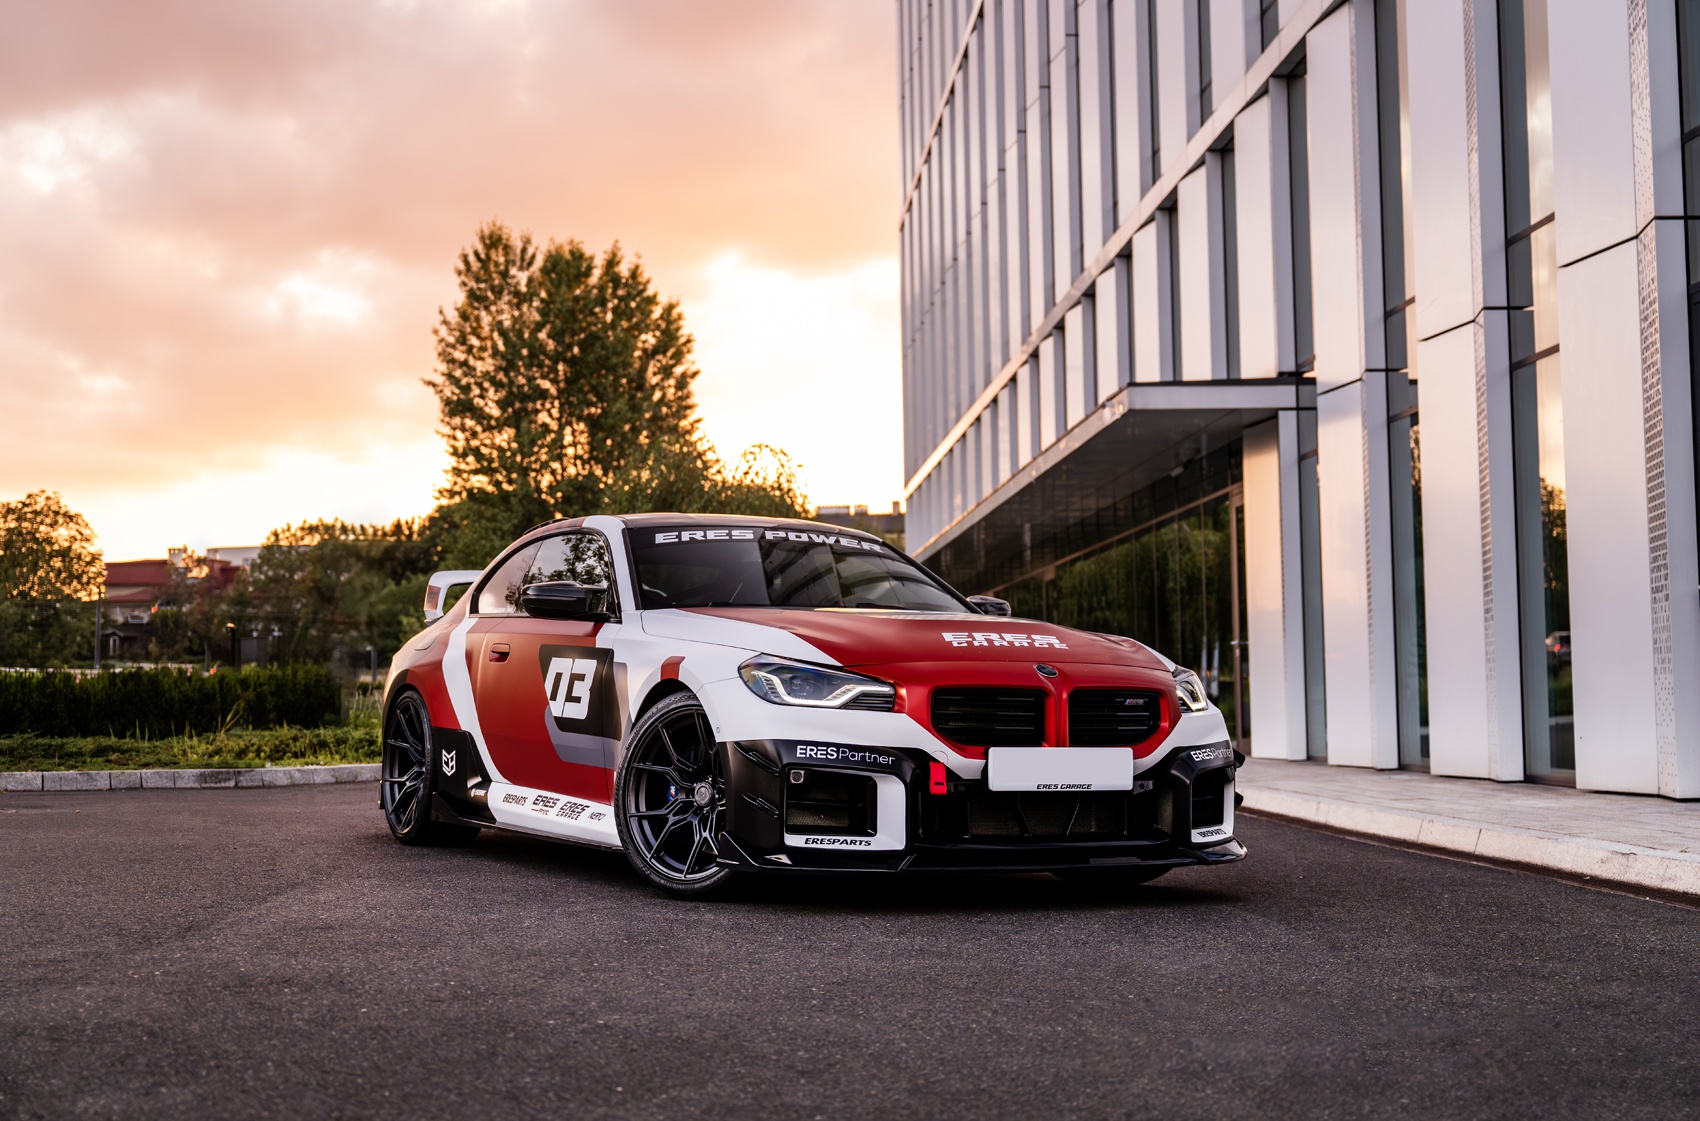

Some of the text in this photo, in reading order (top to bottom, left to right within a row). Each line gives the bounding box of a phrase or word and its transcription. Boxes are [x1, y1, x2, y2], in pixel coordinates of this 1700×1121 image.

[655, 529, 883, 552] ERES POWER
[941, 632, 1061, 644] ERES
[951, 640, 1069, 649] GARAGE
[544, 657, 597, 720] 03
[796, 745, 896, 765] ERES Partner
[1190, 747, 1232, 761] ERES Partne
[532, 794, 560, 809] ERES
[559, 801, 591, 815] ERES
[555, 810, 581, 821] GARAGE
[804, 837, 872, 847] ERESPARTS
